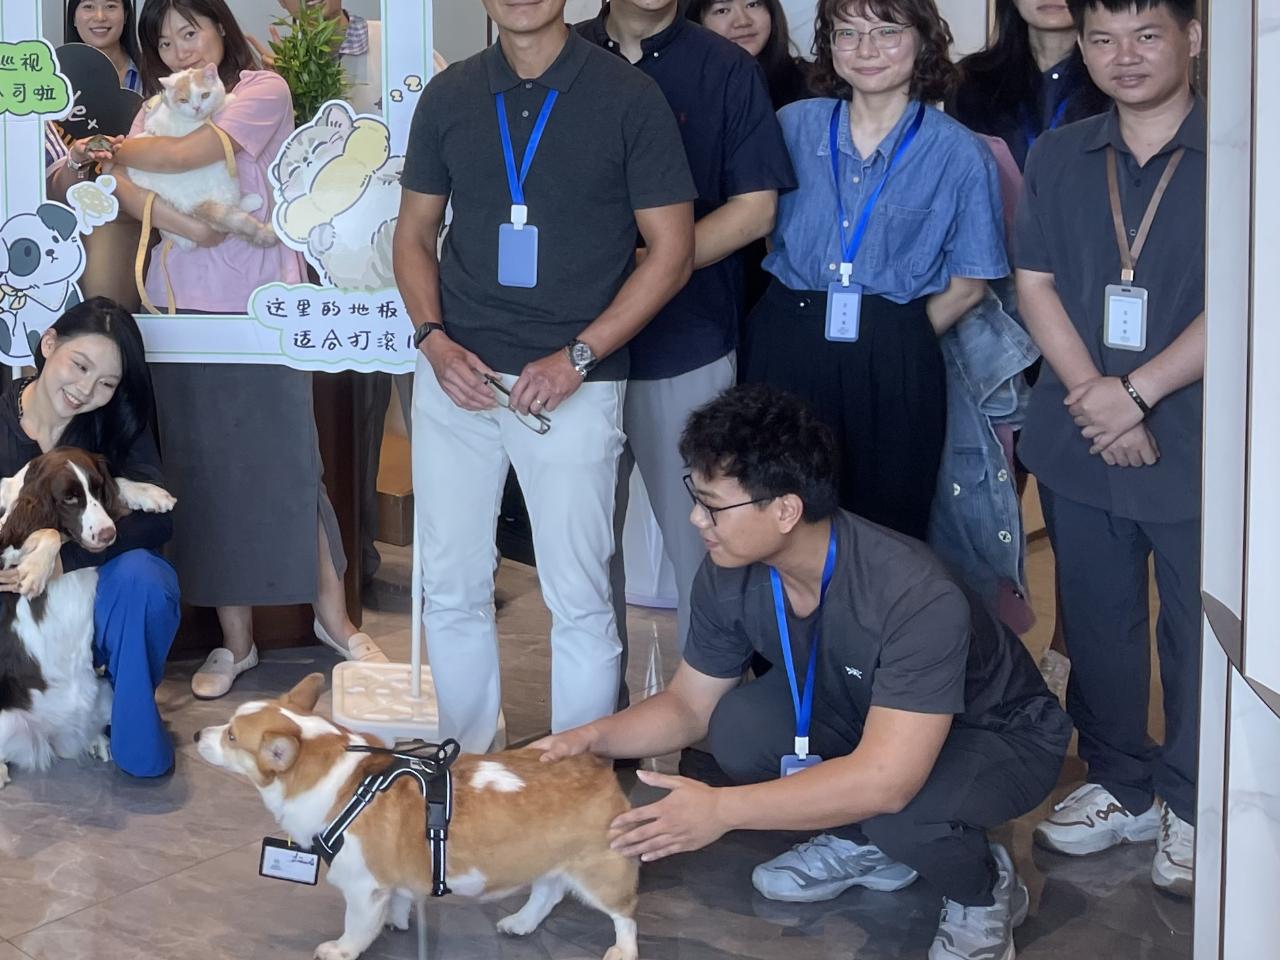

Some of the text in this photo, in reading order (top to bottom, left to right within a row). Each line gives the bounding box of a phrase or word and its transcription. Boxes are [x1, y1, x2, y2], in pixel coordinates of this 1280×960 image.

[265, 297, 398, 320] 这里的地板
